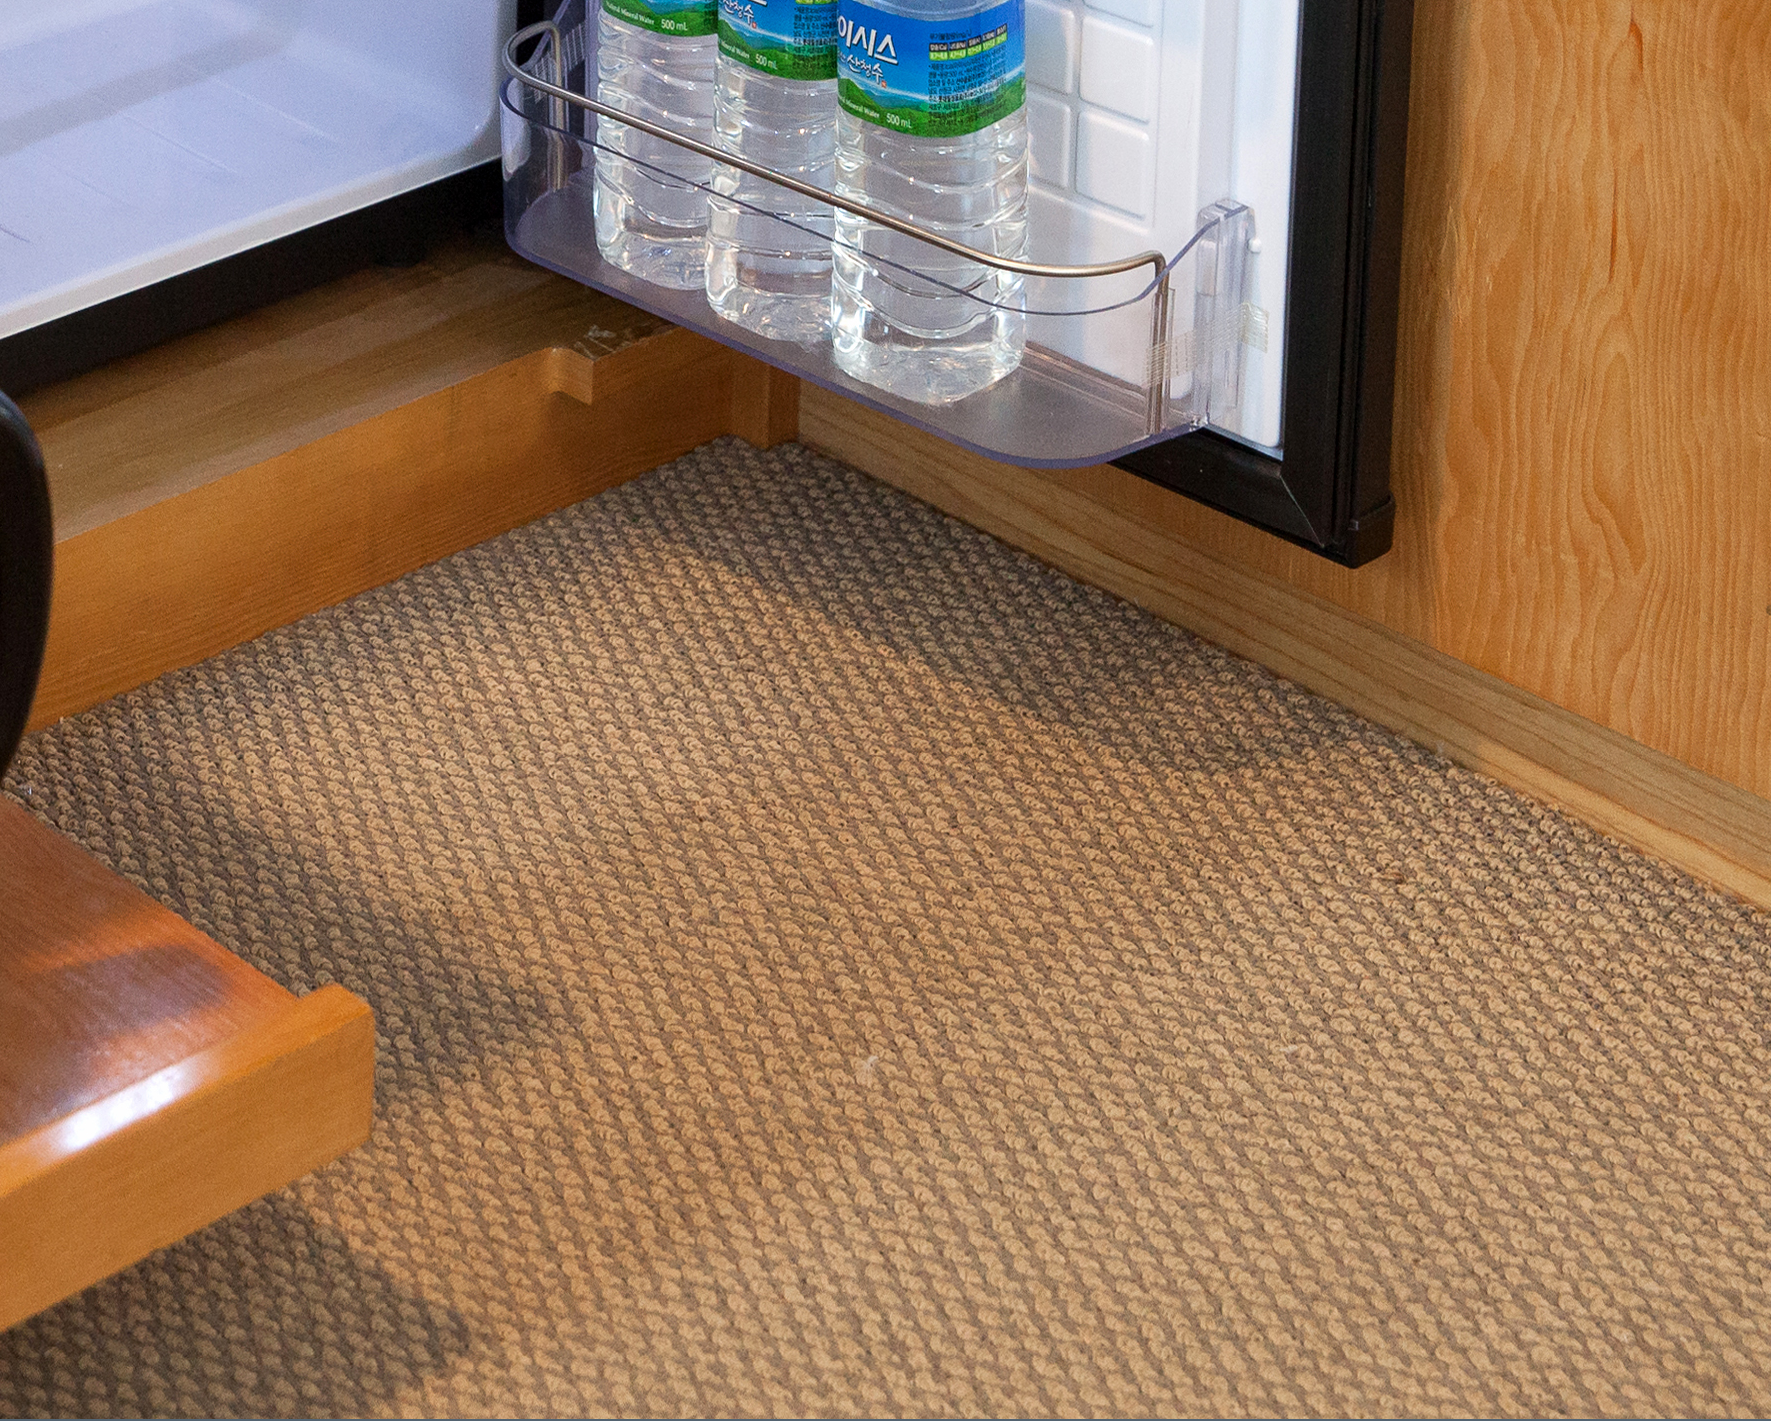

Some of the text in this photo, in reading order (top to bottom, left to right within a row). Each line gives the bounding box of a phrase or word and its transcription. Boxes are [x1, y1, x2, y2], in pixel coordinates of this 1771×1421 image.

[660, 18, 689, 32] 500 mL
[837, 15, 898, 65] 이시스
[755, 53, 768, 67] 500
[846, 54, 884, 85] 산청수
[886, 113, 912, 128] 500 mL
